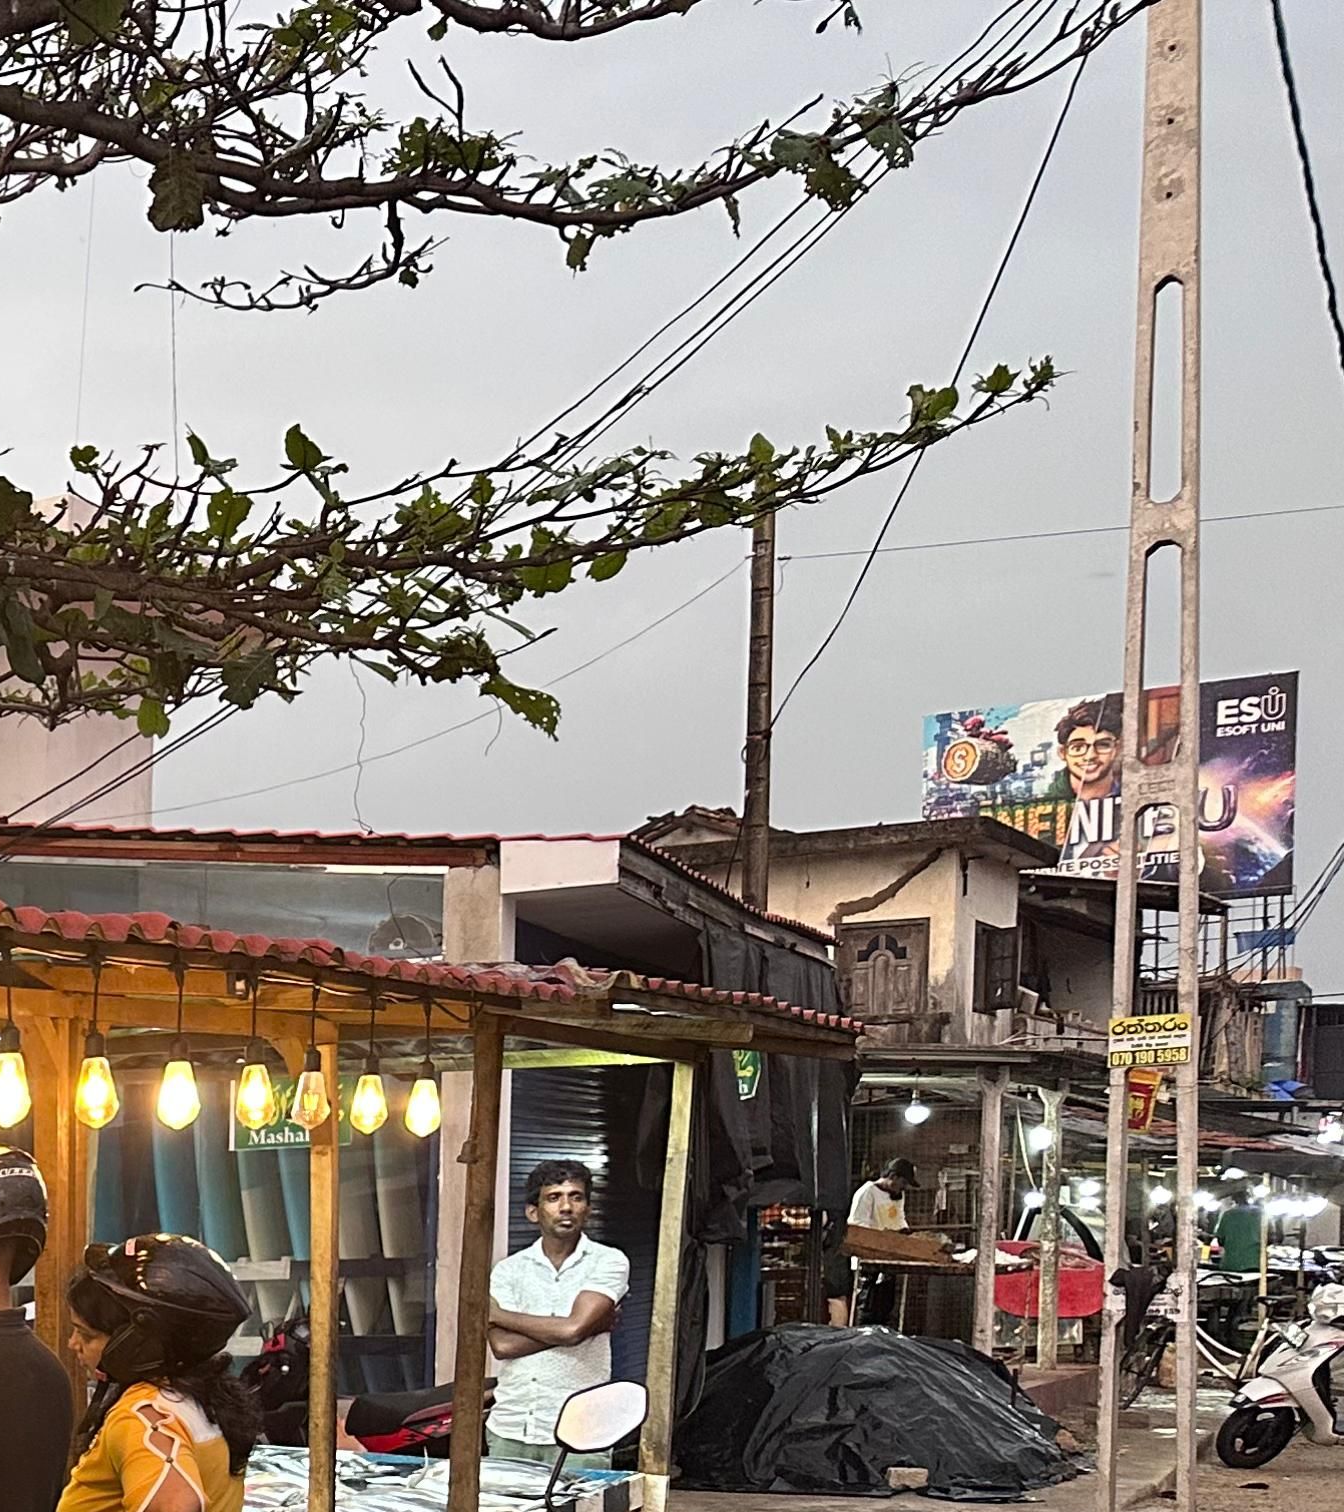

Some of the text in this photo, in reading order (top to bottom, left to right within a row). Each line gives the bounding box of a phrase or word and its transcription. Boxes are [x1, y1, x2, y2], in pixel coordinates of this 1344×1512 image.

[1216, 721, 1286, 737] ESOFT UNI
[1112, 1047, 1187, 1066] 070 190 5958
